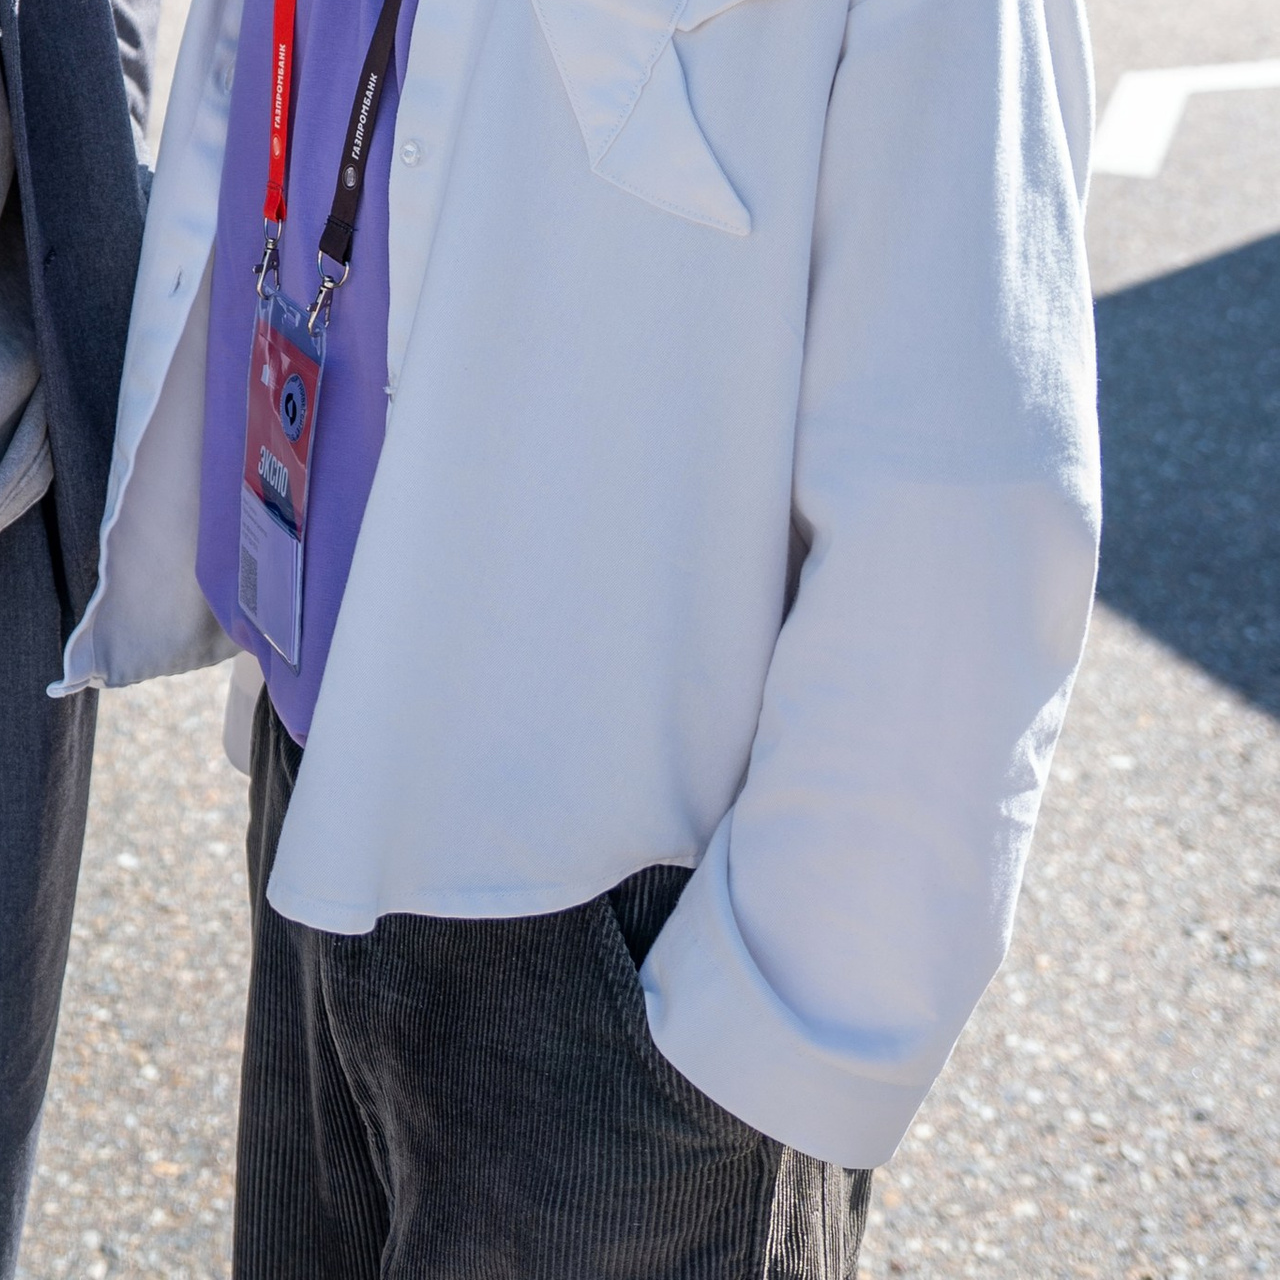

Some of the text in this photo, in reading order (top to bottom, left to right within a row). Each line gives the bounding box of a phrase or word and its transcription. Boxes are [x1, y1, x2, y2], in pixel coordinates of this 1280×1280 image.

[274, 43, 286, 129] ГАЗПРОМБАНК
[351, 73, 378, 160] ГАЗПРОМБАНК
[258, 445, 288, 498] ЭКСПО
